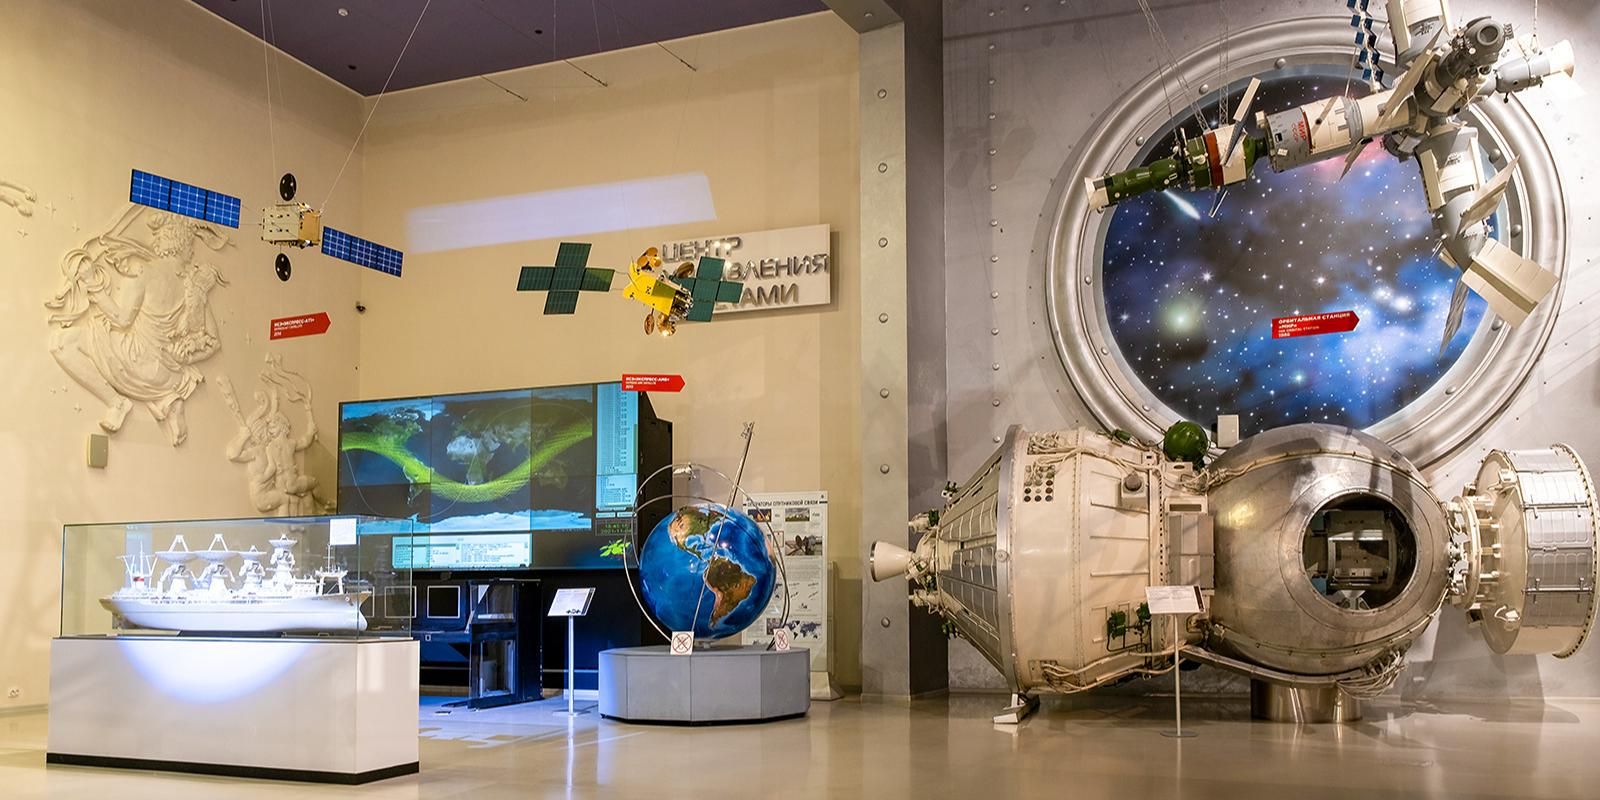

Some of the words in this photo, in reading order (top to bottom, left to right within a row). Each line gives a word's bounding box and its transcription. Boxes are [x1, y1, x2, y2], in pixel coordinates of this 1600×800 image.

[1298, 120, 1307, 141] МИР
[662, 236, 742, 263] ЦЕНТР
[723, 253, 830, 281] ВЛЕНИЯ
[1278, 315, 1321, 324] ОРБИТАЛЬНАЯ
[1322, 312, 1351, 320] СТАНЦИЯ
